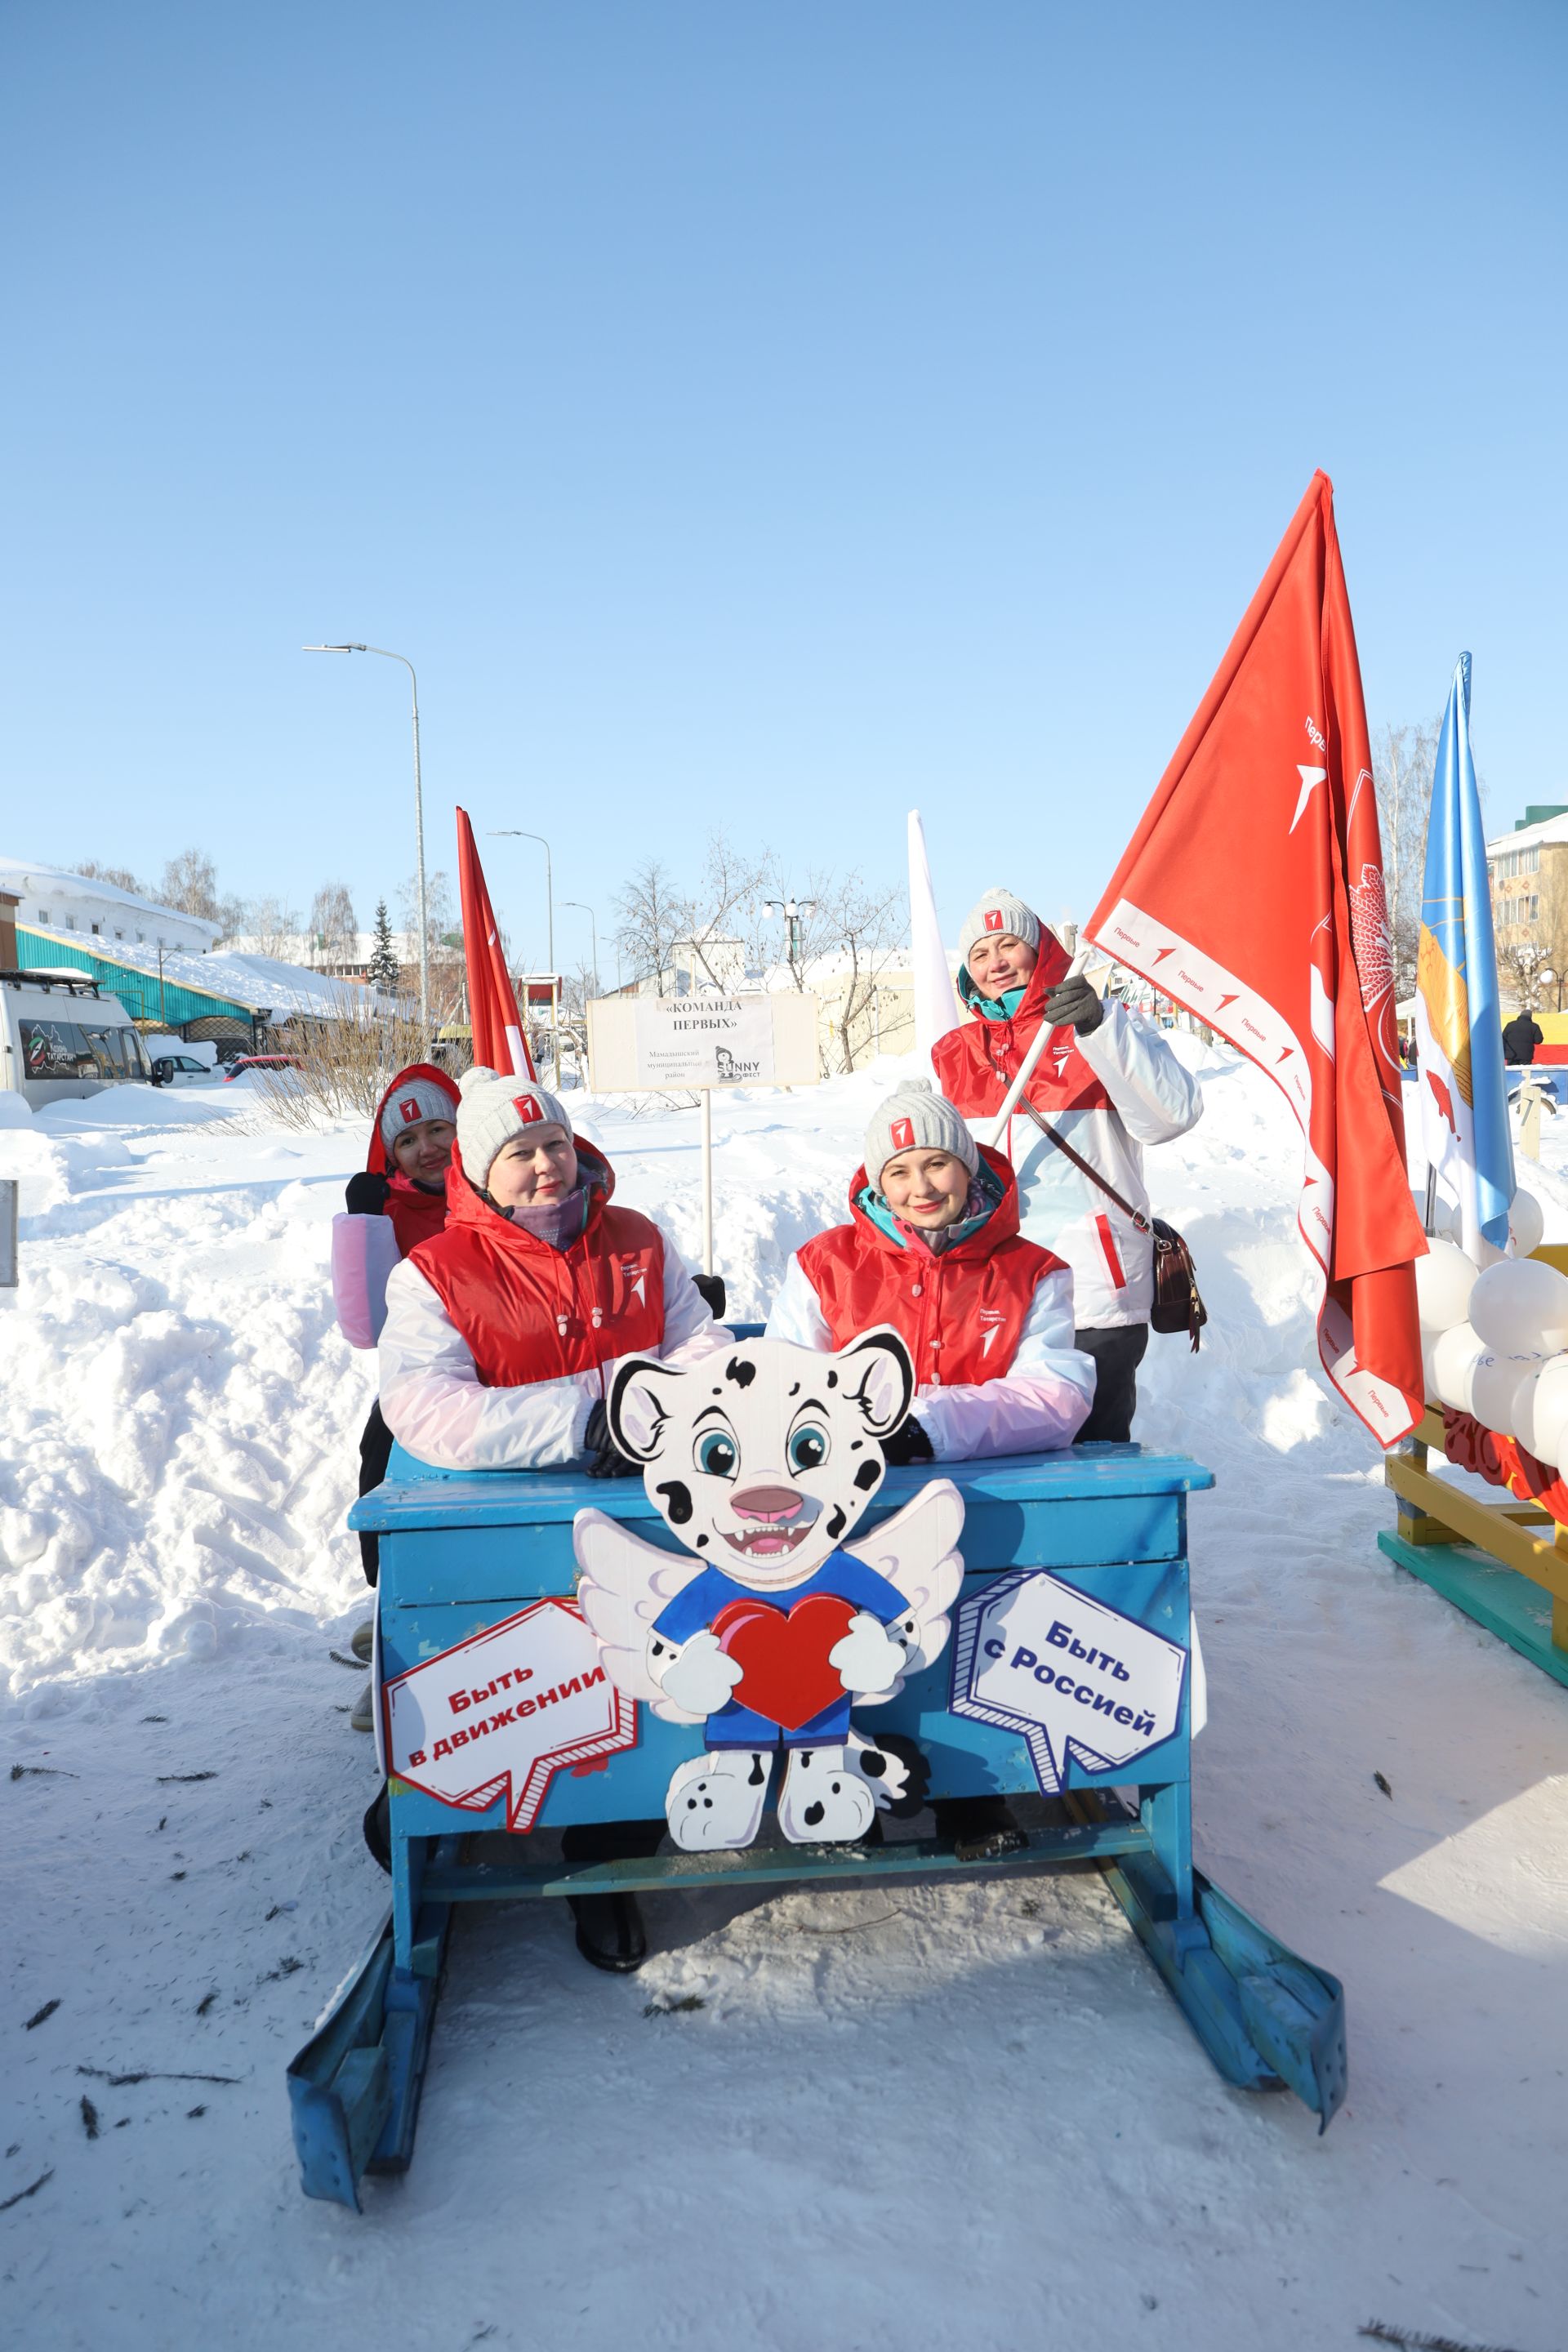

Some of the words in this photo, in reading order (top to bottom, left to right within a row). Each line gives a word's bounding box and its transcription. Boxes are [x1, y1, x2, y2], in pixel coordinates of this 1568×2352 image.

[1305, 715, 1326, 752] Перв
[1113, 927, 1140, 948] Первые
[1178, 970, 1205, 992] Первые
[666, 1000, 742, 1013] «КОМАНДА
[673, 1018, 737, 1031] ПЕРВЫХ»
[1241, 1018, 1267, 1042] Первые
[649, 1050, 699, 1058] Мамадышский
[665, 1071, 685, 1080] район
[718, 1062, 760, 1072] SUNNY
[1323, 1328, 1340, 1354] Первые
[1368, 1390, 1389, 1418] Первые
[1045, 1619, 1130, 1682] Быть
[448, 1667, 534, 1714] Быть
[984, 1639, 1005, 1659] с
[1010, 1646, 1156, 1736] Россией
[408, 1751, 428, 1768] в
[432, 1665, 607, 1761] движении
